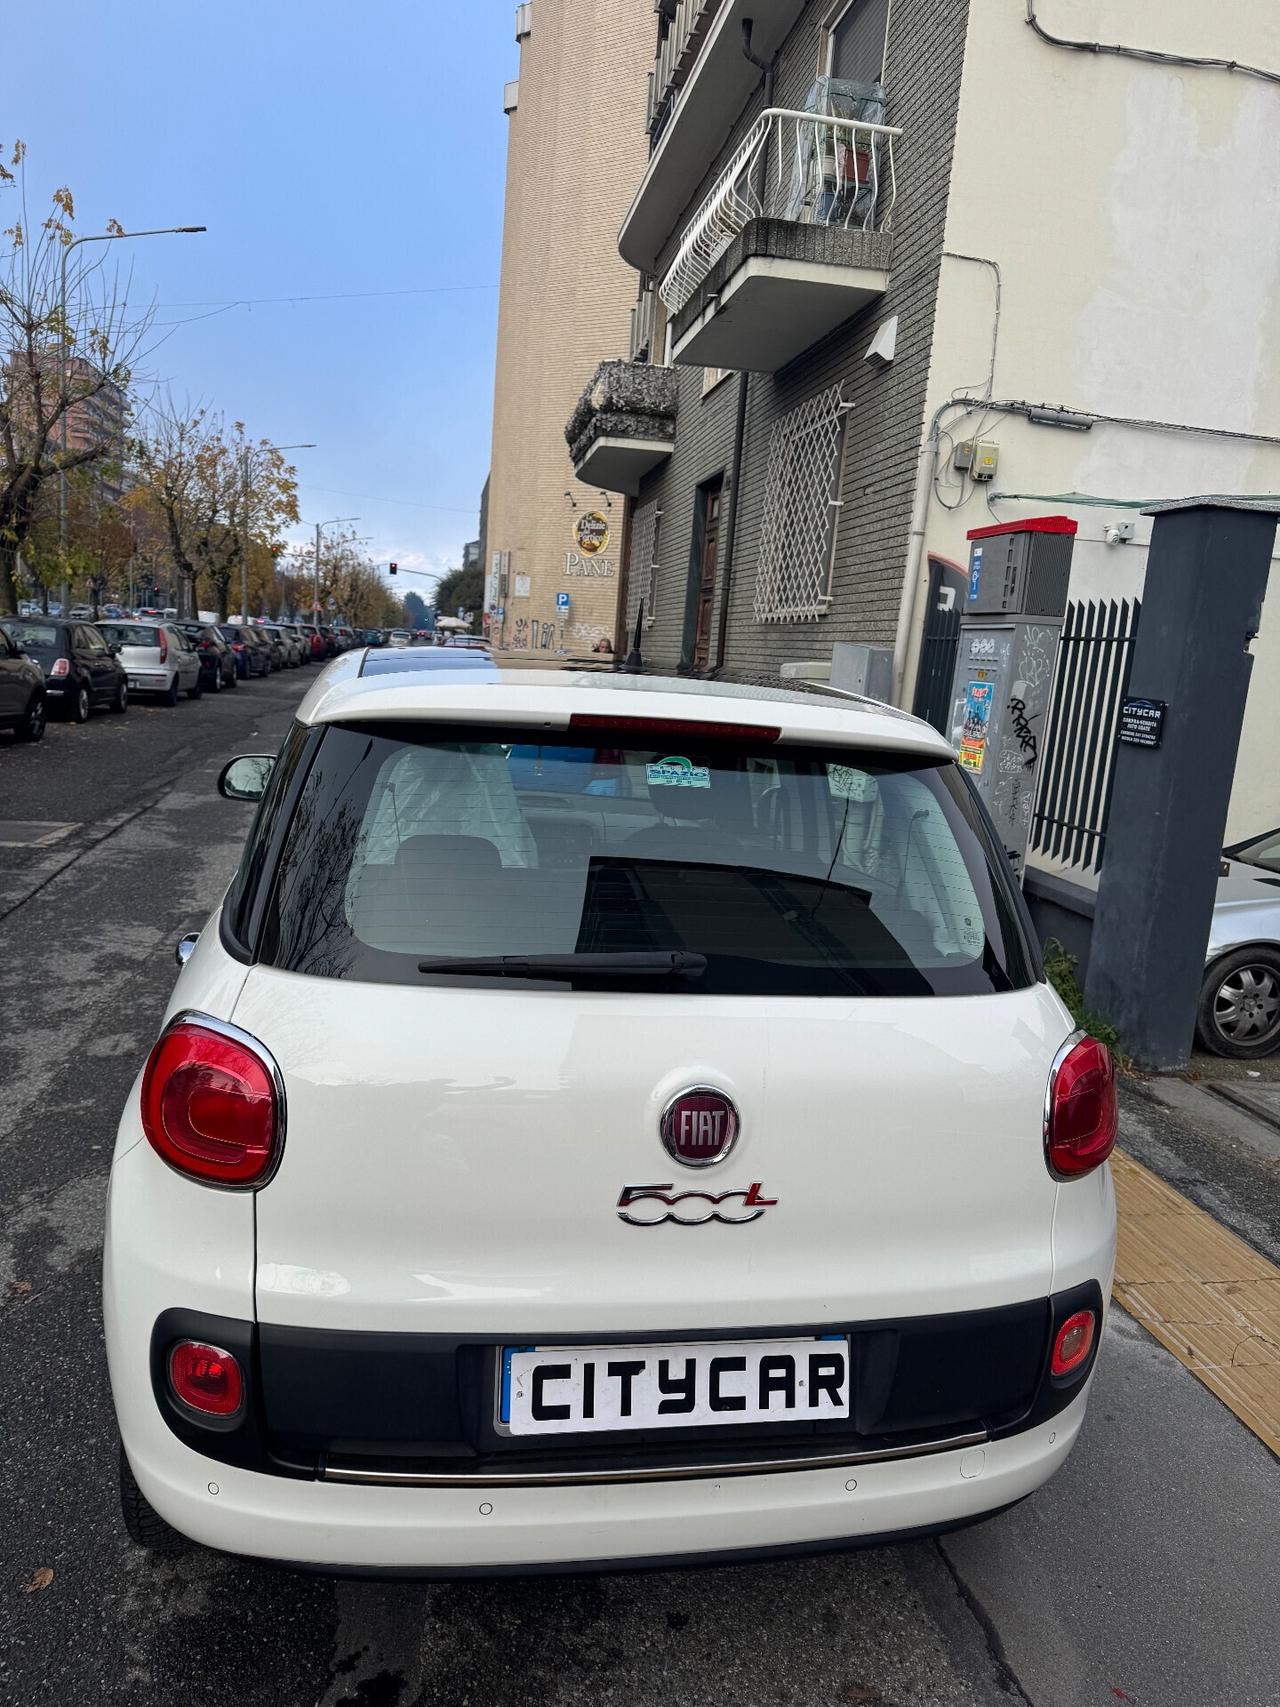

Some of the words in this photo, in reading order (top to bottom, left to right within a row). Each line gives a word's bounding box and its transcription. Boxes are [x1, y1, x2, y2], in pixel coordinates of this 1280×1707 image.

[564, 552, 616, 577] PANE
[558, 594, 568, 605] P
[1123, 706, 1160, 718] CITYCAR
[679, 1109, 725, 1147] FIAT
[531, 1352, 846, 1422] CITYCAR
